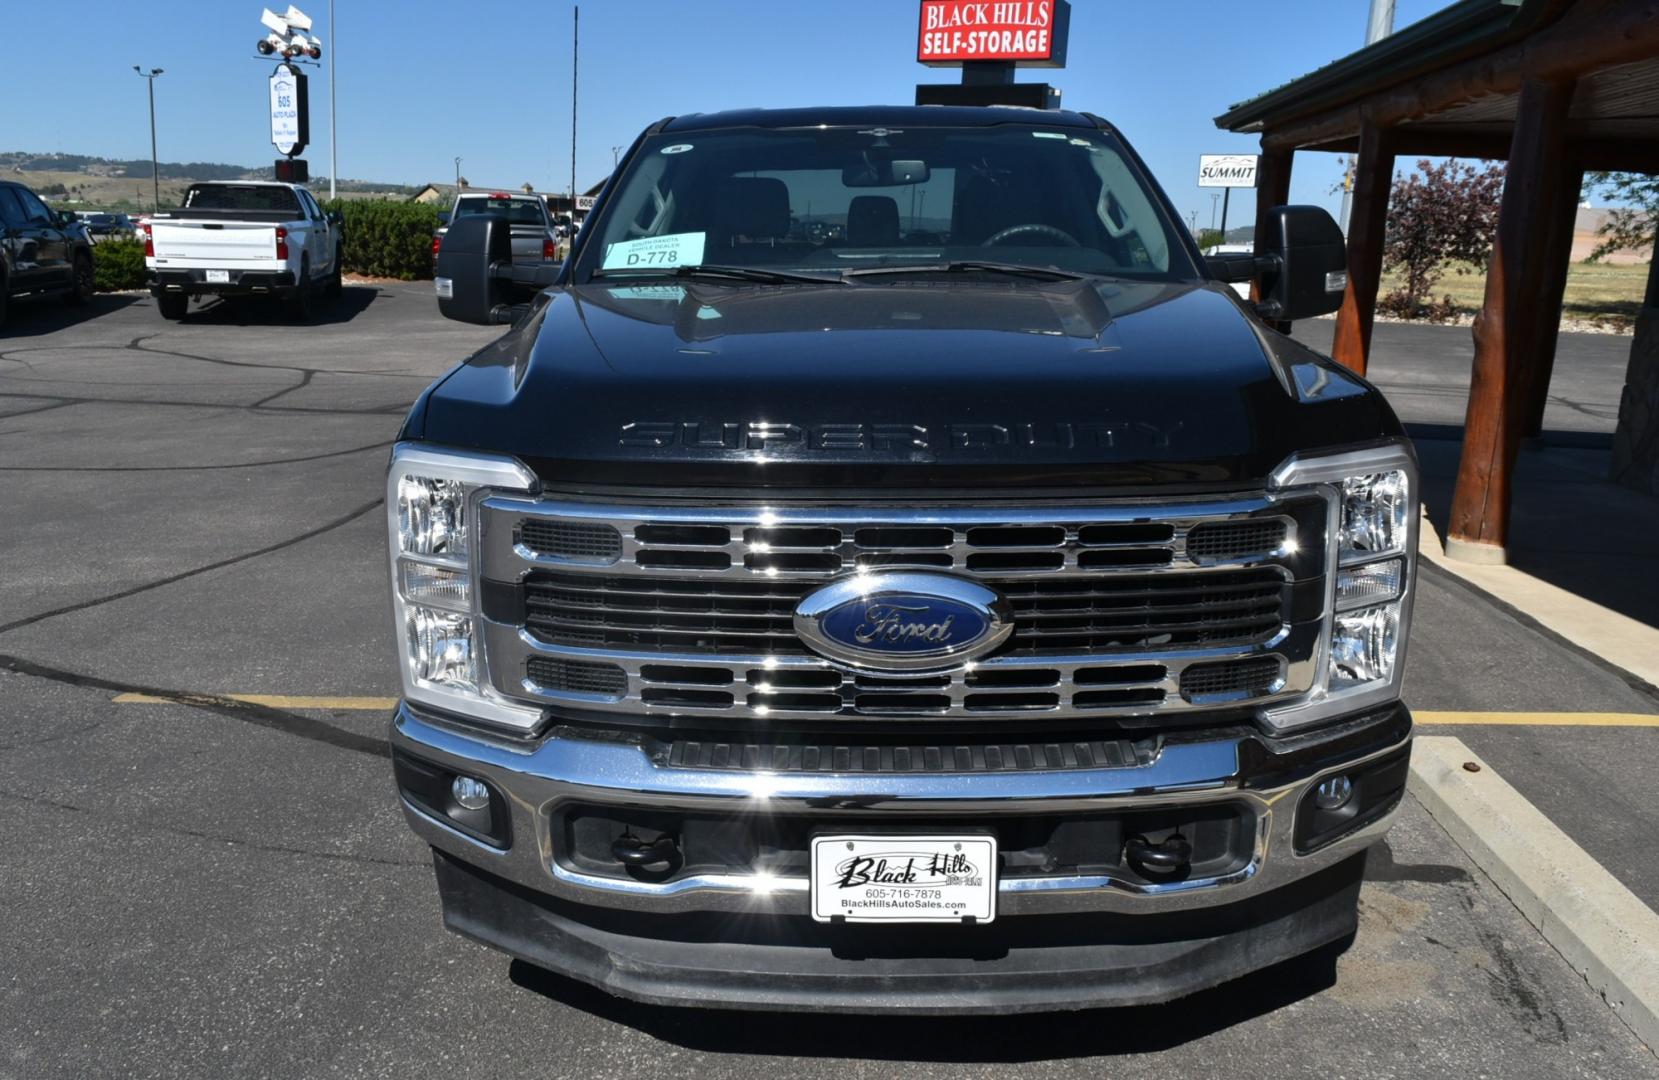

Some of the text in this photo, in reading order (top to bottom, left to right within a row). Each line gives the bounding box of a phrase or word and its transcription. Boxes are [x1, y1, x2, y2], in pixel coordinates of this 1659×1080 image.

[926, 1, 1049, 31] BLACK HILLS
[923, 29, 1048, 55] SELF-STORAGE
[278, 95, 291, 108] 605
[1200, 167, 1255, 178] SUMMIT
[579, 198, 593, 208] 605
[655, 242, 680, 250] DEALER
[627, 251, 677, 265] D-778
[619, 420, 1186, 450] SUPER DUTY
[855, 603, 955, 643] Ford
[832, 852, 972, 888] Black Hills
[865, 888, 942, 899] 605-716-7878
[841, 899, 967, 909] BlackHillsAutoSales.com
